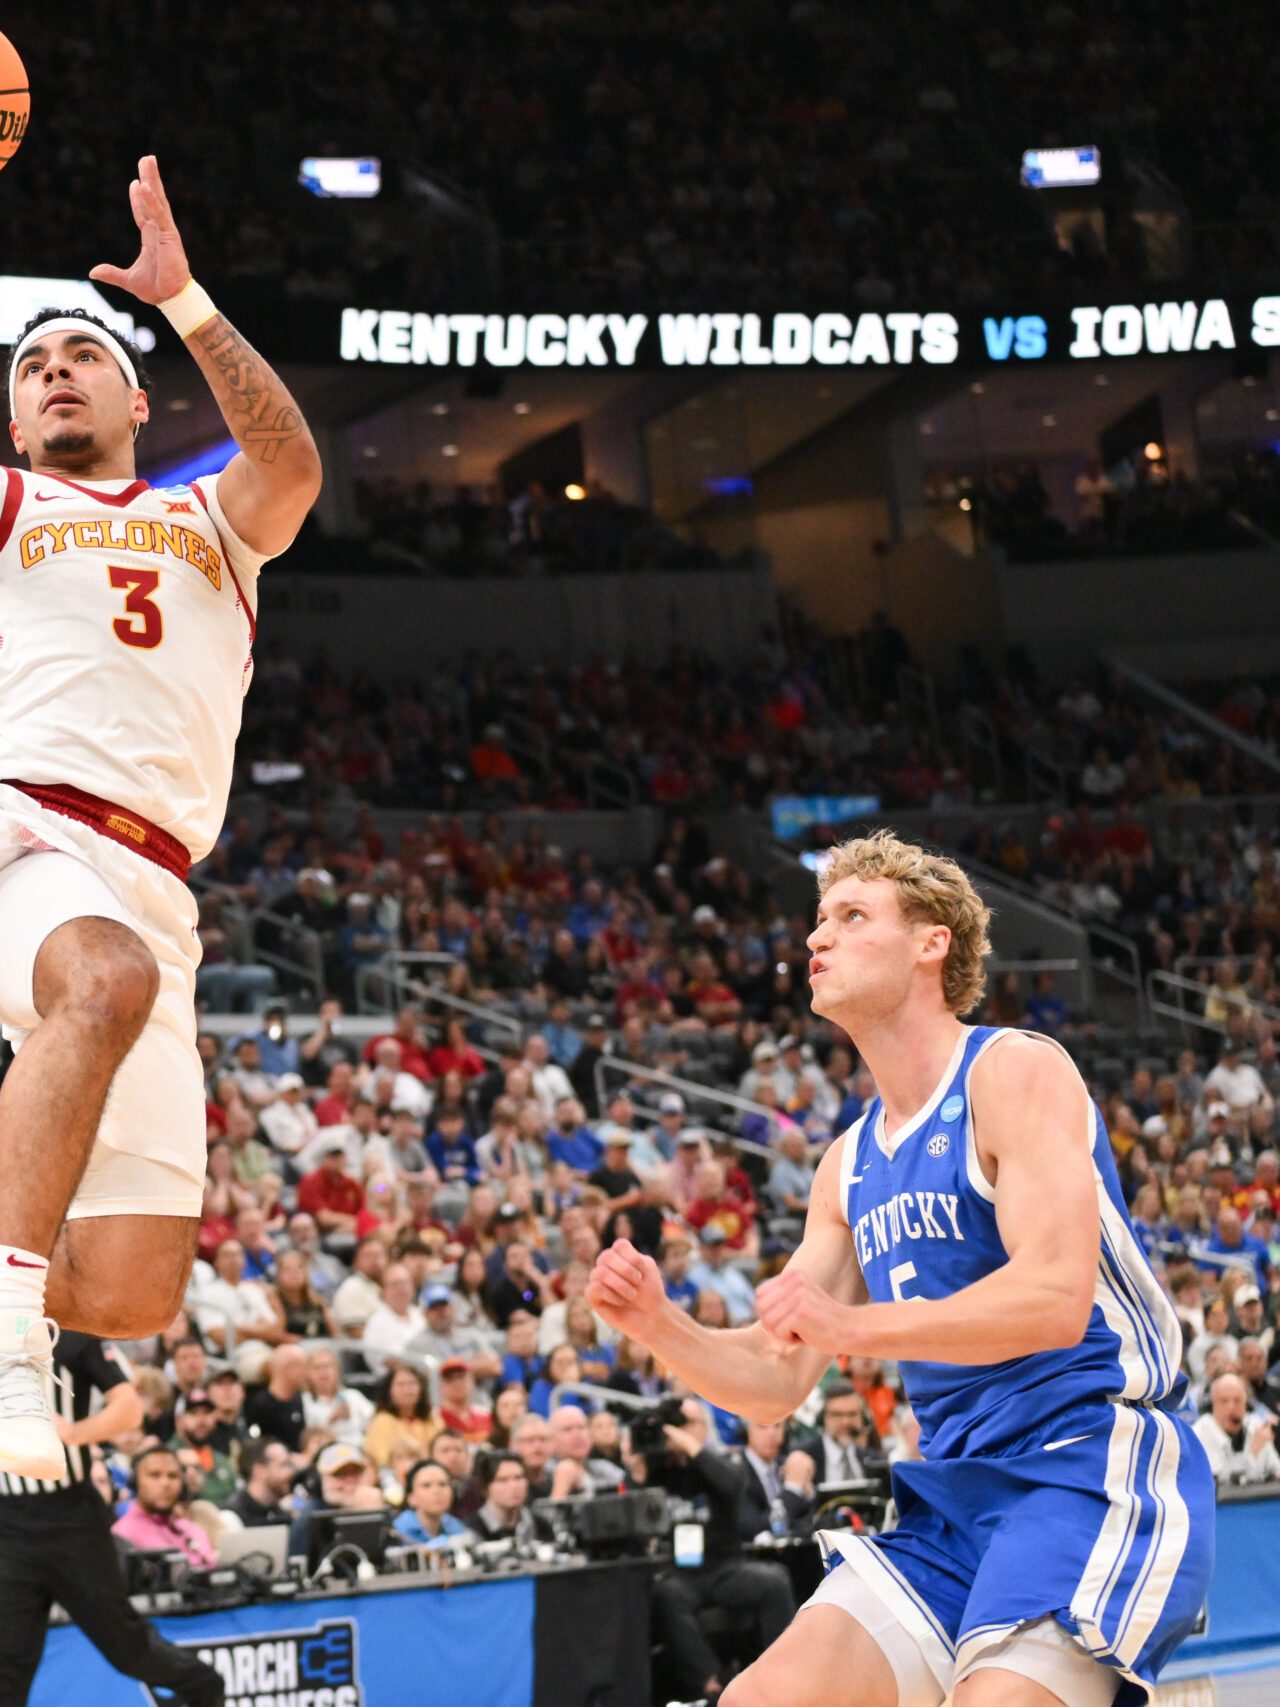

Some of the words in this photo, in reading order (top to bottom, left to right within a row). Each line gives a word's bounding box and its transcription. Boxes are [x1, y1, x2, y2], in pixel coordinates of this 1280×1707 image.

[340, 308, 648, 367] KENTUCKY
[658, 313, 959, 365] WILDCATS
[983, 315, 1048, 361] VS
[1070, 298, 1237, 359] IOWA
[19, 520, 221, 592] CYCLONES
[107, 564, 163, 651] 3
[928, 1134, 948, 1157] SEC
[197, 1640, 299, 1697] ARCH
